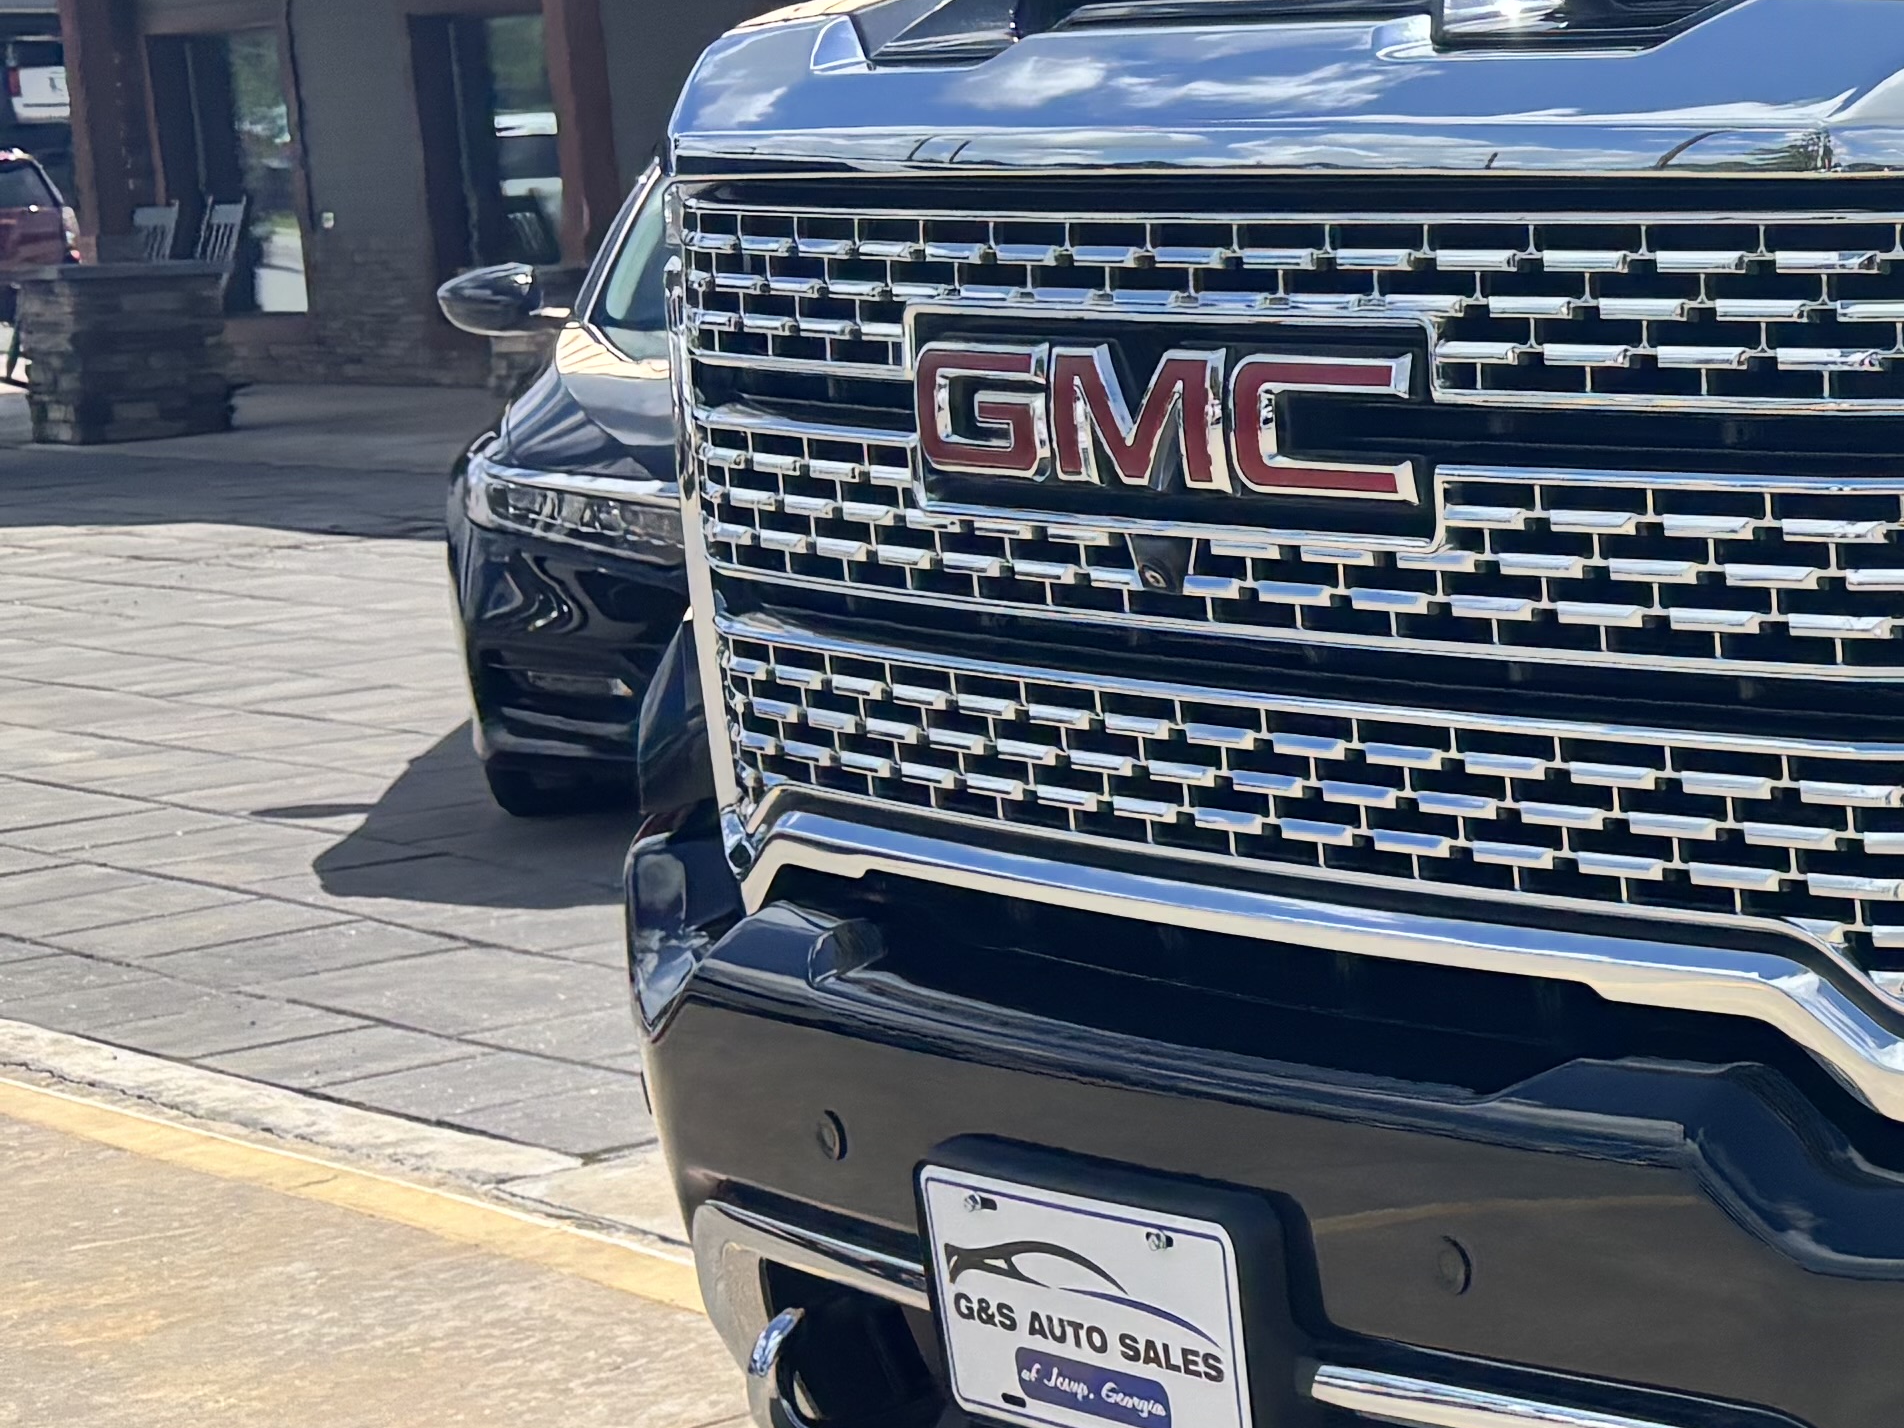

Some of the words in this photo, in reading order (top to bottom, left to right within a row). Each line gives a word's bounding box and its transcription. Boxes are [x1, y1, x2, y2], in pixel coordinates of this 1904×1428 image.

[915, 340, 1419, 506] GMC
[953, 1291, 1018, 1332] G&S
[1028, 1310, 1109, 1354] AUTO
[1118, 1332, 1225, 1383] SALES
[1020, 1362, 1042, 1382] of
[1100, 1381, 1167, 1419] Georgia
